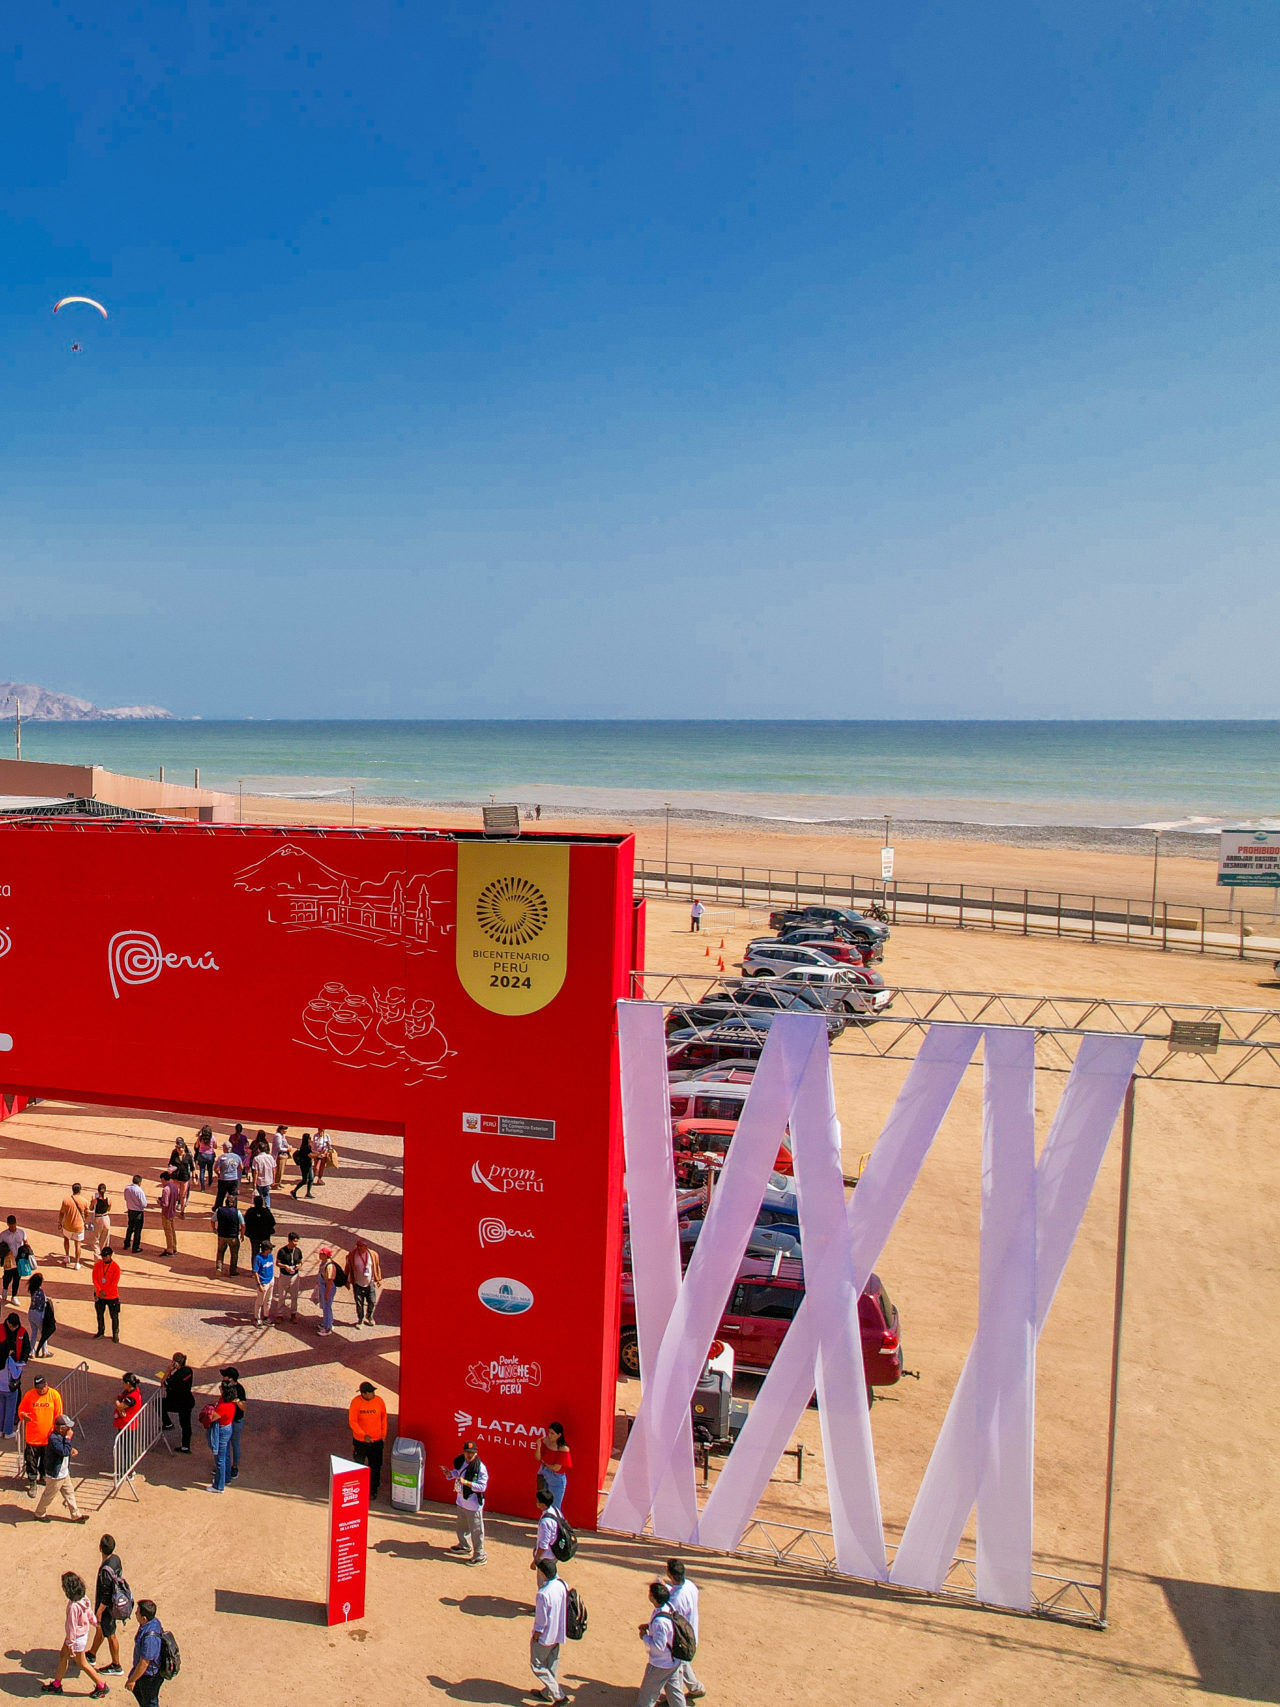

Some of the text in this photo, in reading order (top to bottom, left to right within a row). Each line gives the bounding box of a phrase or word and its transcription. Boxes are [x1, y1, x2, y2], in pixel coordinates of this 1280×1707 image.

[1238, 846, 1280, 854] PROHIBIDO
[472, 950, 550, 962] BICENTENARIO
[108, 929, 220, 999] Perú
[493, 961, 528, 973] PERÚ
[490, 975, 532, 989] 2024
[487, 1164, 536, 1180] prom
[503, 1178, 544, 1193] perú
[478, 1217, 535, 1248] Perú
[500, 1355, 519, 1365] Ponle
[490, 1360, 530, 1379] PUNCHE
[500, 1382, 522, 1395] PERÚ
[478, 1417, 546, 1438] LATAM
[477, 1434, 537, 1450] AIRLINE
